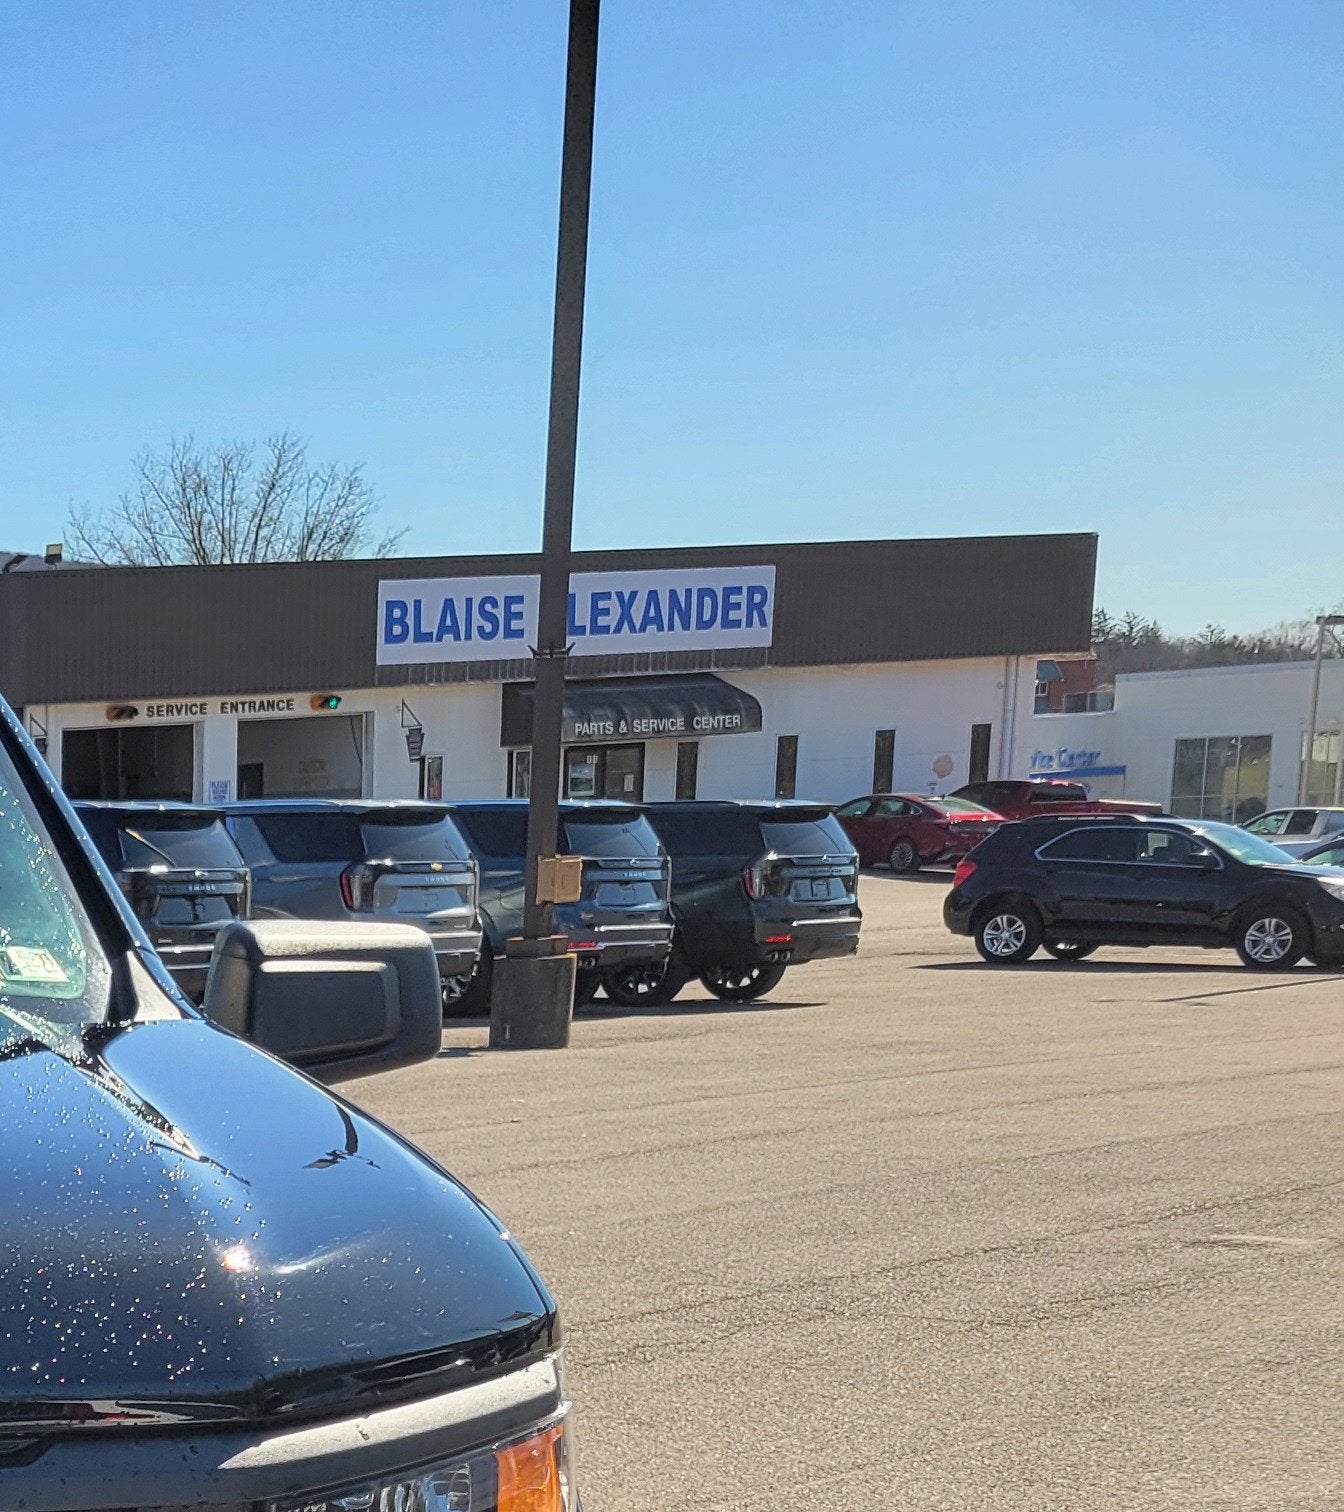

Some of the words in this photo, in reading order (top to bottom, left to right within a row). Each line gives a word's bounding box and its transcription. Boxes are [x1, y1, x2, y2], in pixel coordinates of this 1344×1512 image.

[384, 595, 524, 644] BLAISE
[567, 585, 769, 637] LEXANDER
[146, 703, 207, 717] SERVICE
[220, 699, 295, 714] ENTRANCE
[574, 722, 614, 736] PARTS
[619, 721, 628, 733] &
[633, 717, 685, 732] SERVICE
[693, 714, 741, 729] CENTER
